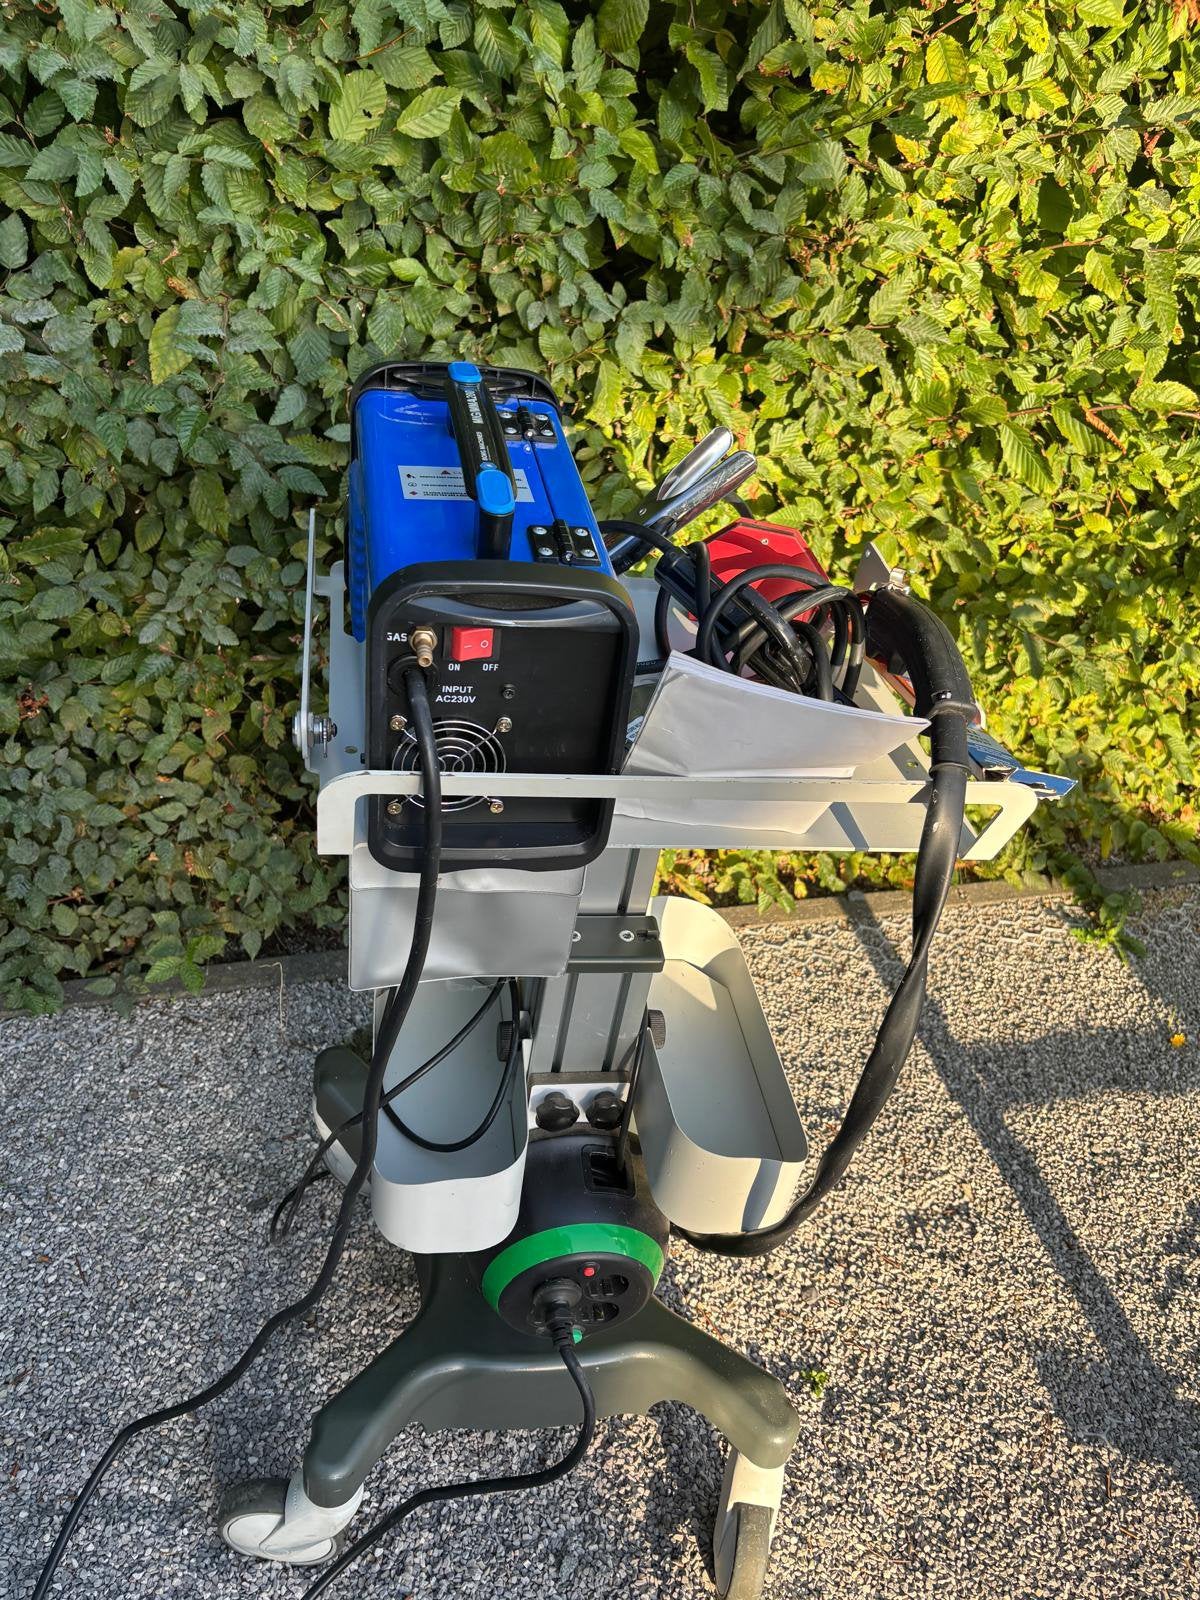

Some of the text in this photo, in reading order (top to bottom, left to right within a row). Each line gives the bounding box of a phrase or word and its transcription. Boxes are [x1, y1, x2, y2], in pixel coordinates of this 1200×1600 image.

[448, 663, 499, 672] ON OFF
[442, 685, 474, 694] INPUT
[435, 695, 477, 704] AC230V
